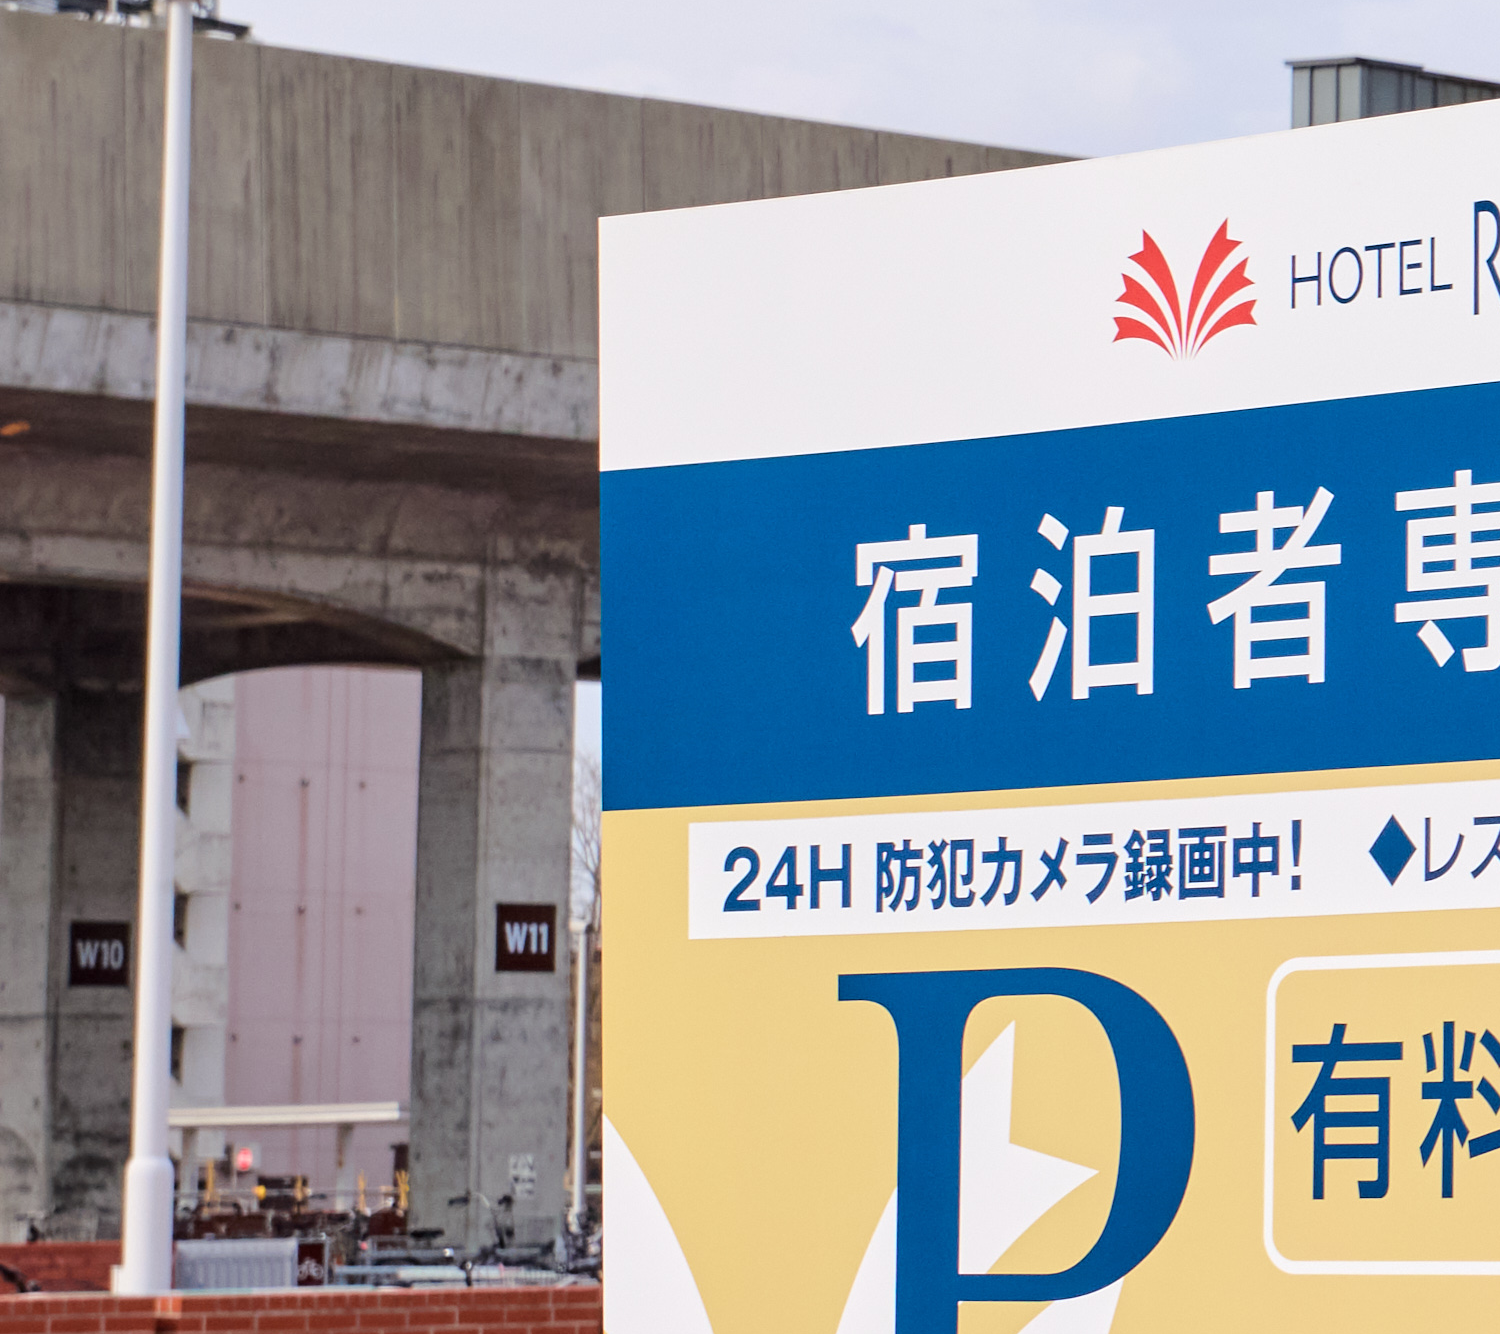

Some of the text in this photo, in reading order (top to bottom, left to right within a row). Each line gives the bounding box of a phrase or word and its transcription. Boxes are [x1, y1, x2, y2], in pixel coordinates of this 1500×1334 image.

[1290, 236, 1453, 309] HOTEL
[722, 843, 853, 913] 24H
[76, 938, 125, 971] W10
[504, 921, 549, 955] W11
